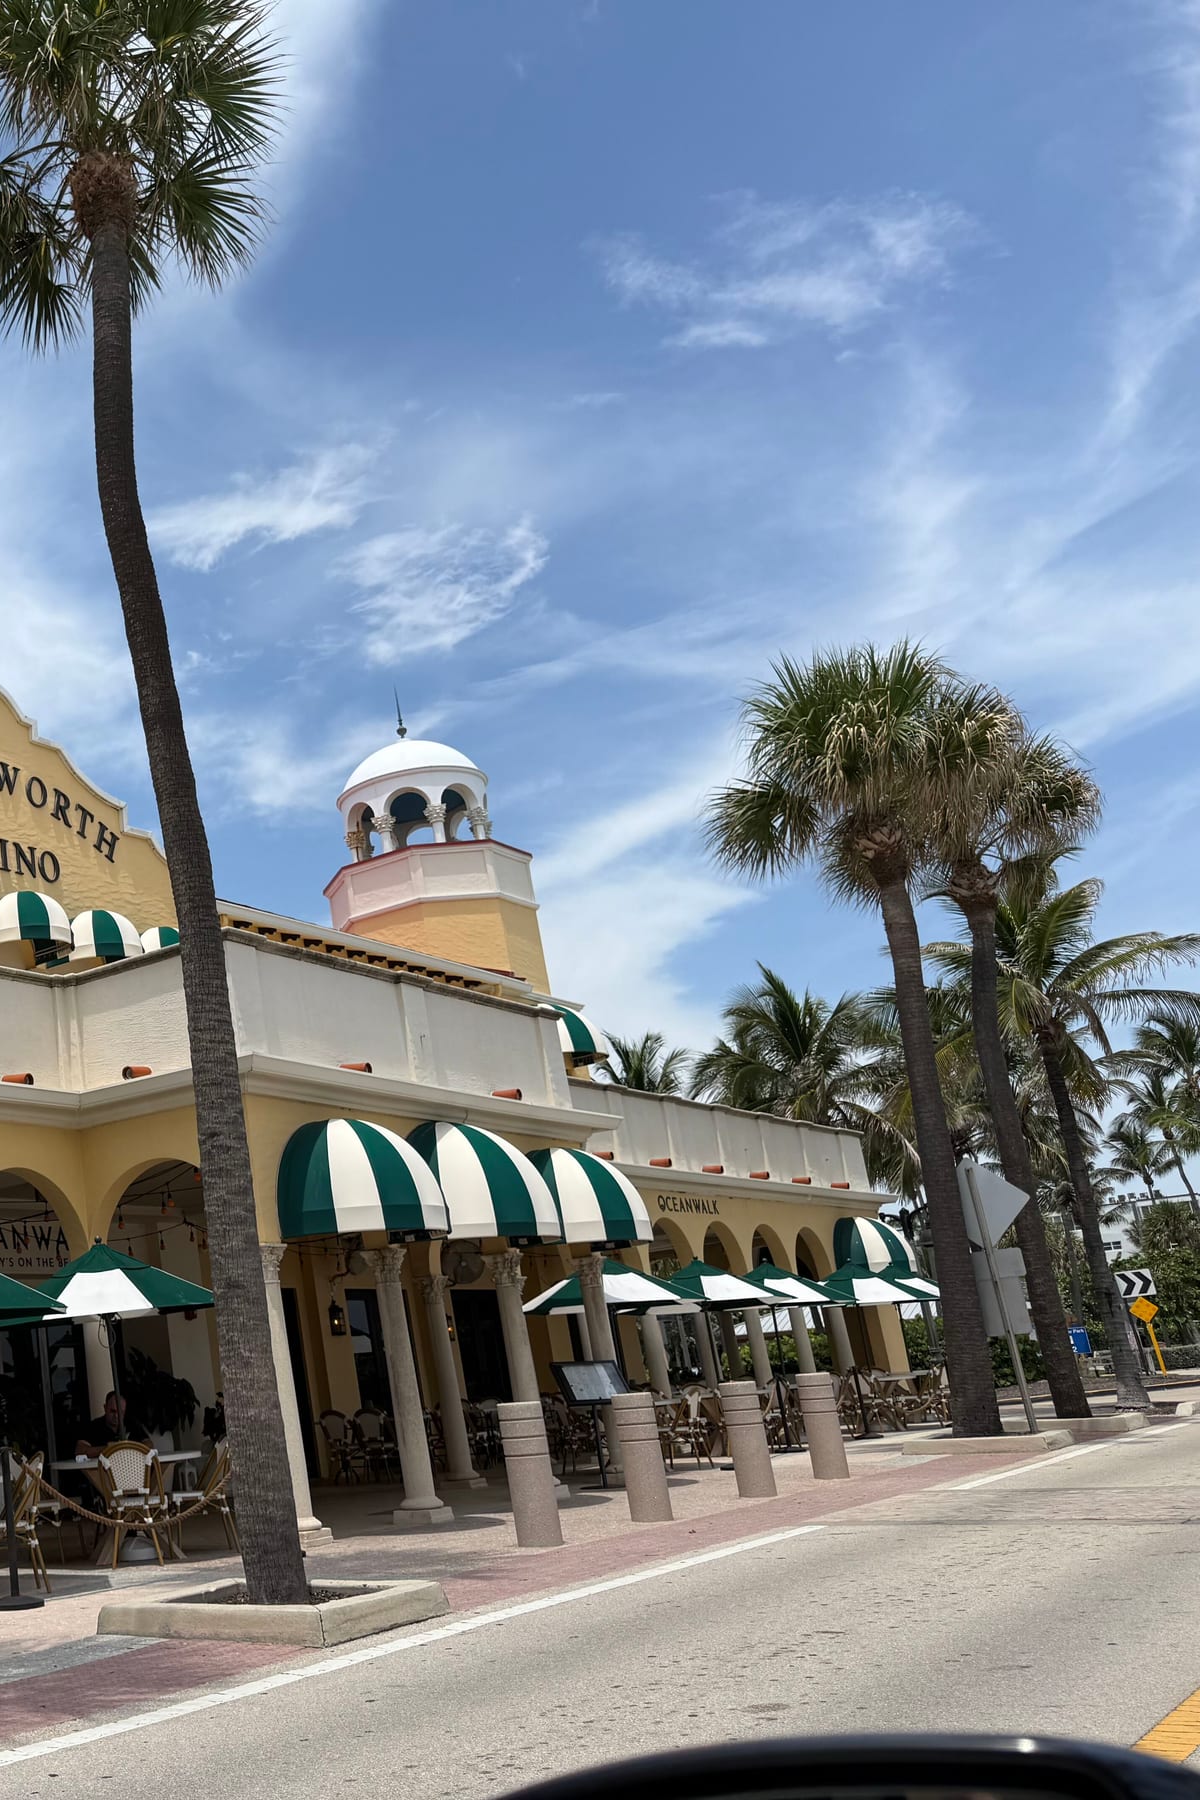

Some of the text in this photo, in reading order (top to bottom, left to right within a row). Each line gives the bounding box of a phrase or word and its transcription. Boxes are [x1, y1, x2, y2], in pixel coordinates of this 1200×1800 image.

[657, 1194, 720, 1215] OCEANWALK
[17, 1257, 33, 1268] ON
[36, 1256, 55, 1268] THE
